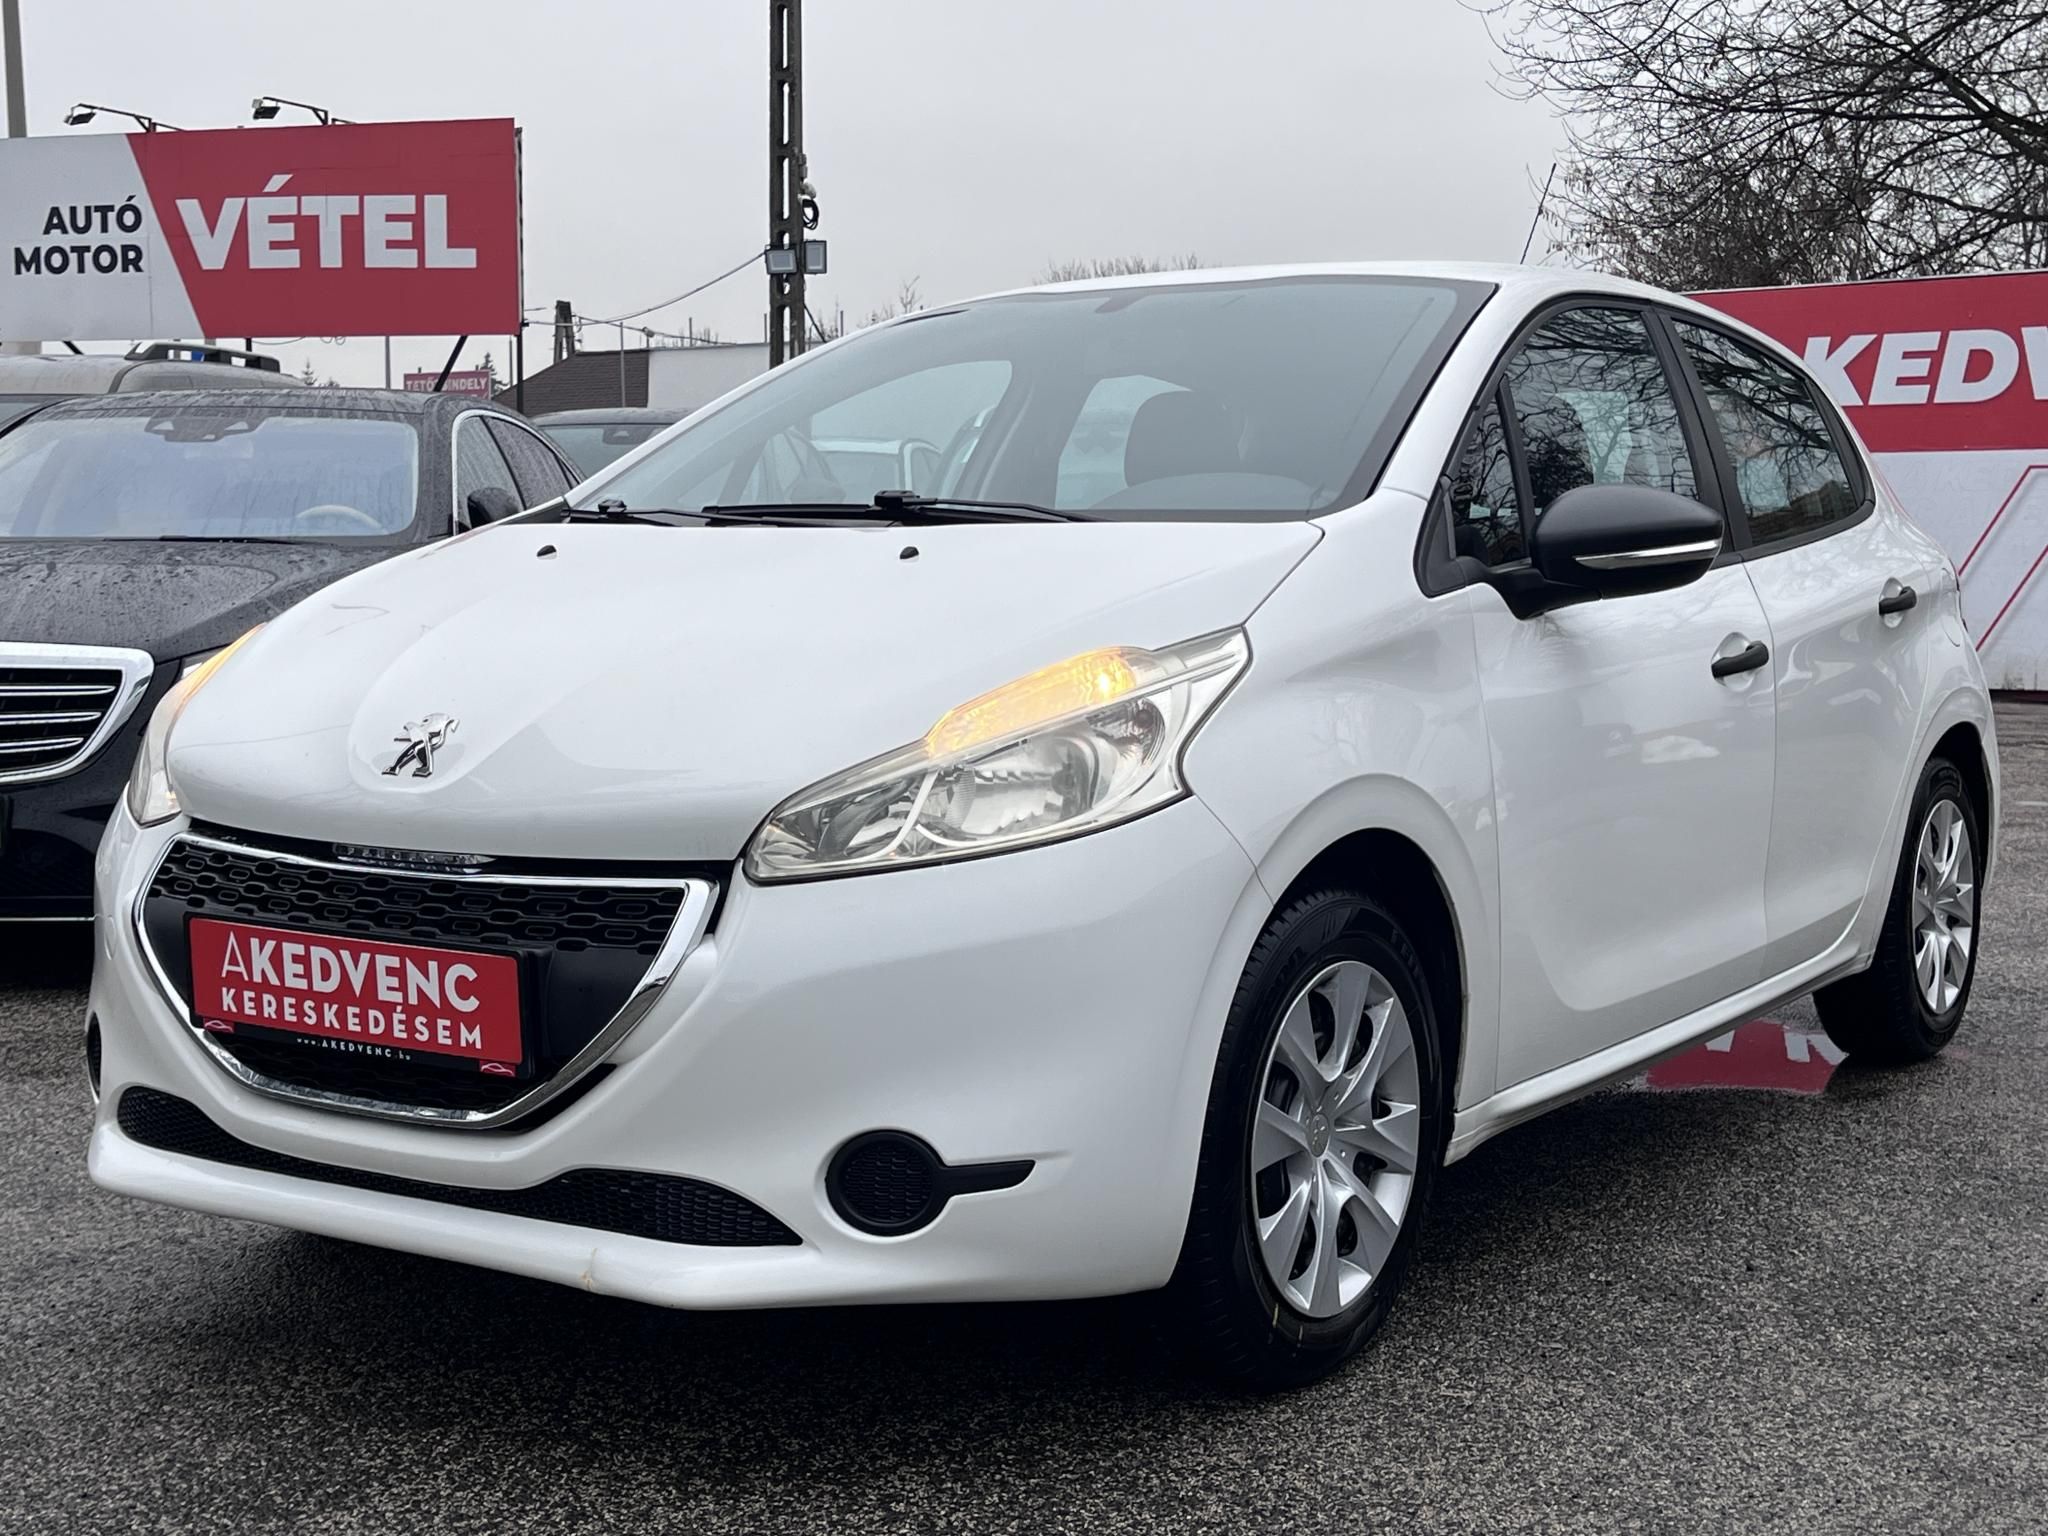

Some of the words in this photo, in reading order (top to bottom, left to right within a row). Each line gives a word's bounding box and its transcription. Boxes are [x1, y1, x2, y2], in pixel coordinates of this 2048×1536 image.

[43, 195, 142, 235] AUTÓ
[175, 174, 477, 270] VÉTEL
[14, 244, 144, 275] MOTOR
[221, 931, 480, 1013] AKEDVENC
[221, 987, 482, 1049] KERESKEDÉSEM
